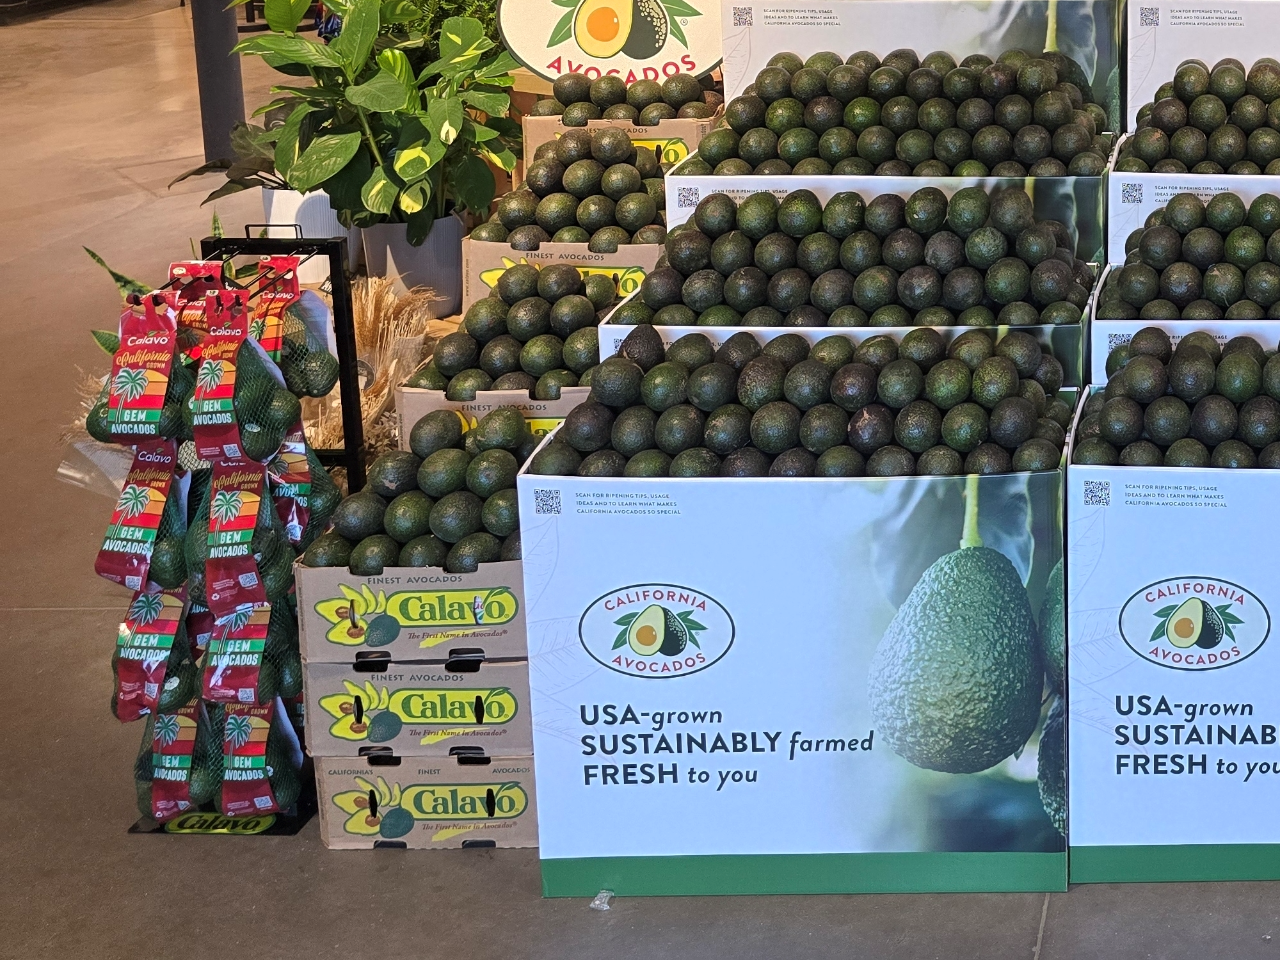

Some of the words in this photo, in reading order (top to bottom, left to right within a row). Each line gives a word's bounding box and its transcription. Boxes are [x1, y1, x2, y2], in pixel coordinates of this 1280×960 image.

[127, 336, 169, 346] Calavo
[116, 350, 171, 367] California
[124, 410, 146, 421] GEM
[111, 424, 156, 434] AVOCADOS
[406, 576, 462, 584] AVOCADOS
[604, 589, 706, 612] CALIFORNIA
[1145, 582, 1246, 605] CALIFORNIA
[612, 652, 706, 673] AVOCADOS
[1149, 646, 1241, 665] AVOCADOS
[579, 704, 723, 731] USA-grown
[1115, 695, 1253, 722] USA-grown
[580, 731, 782, 756] SUSTAINABLY
[789, 730, 873, 760] farmed
[1116, 754, 1207, 775] FRESH
[1216, 756, 1237, 774] to
[584, 764, 678, 785] FRESH
[688, 765, 710, 785] to
[716, 768, 758, 791] you
